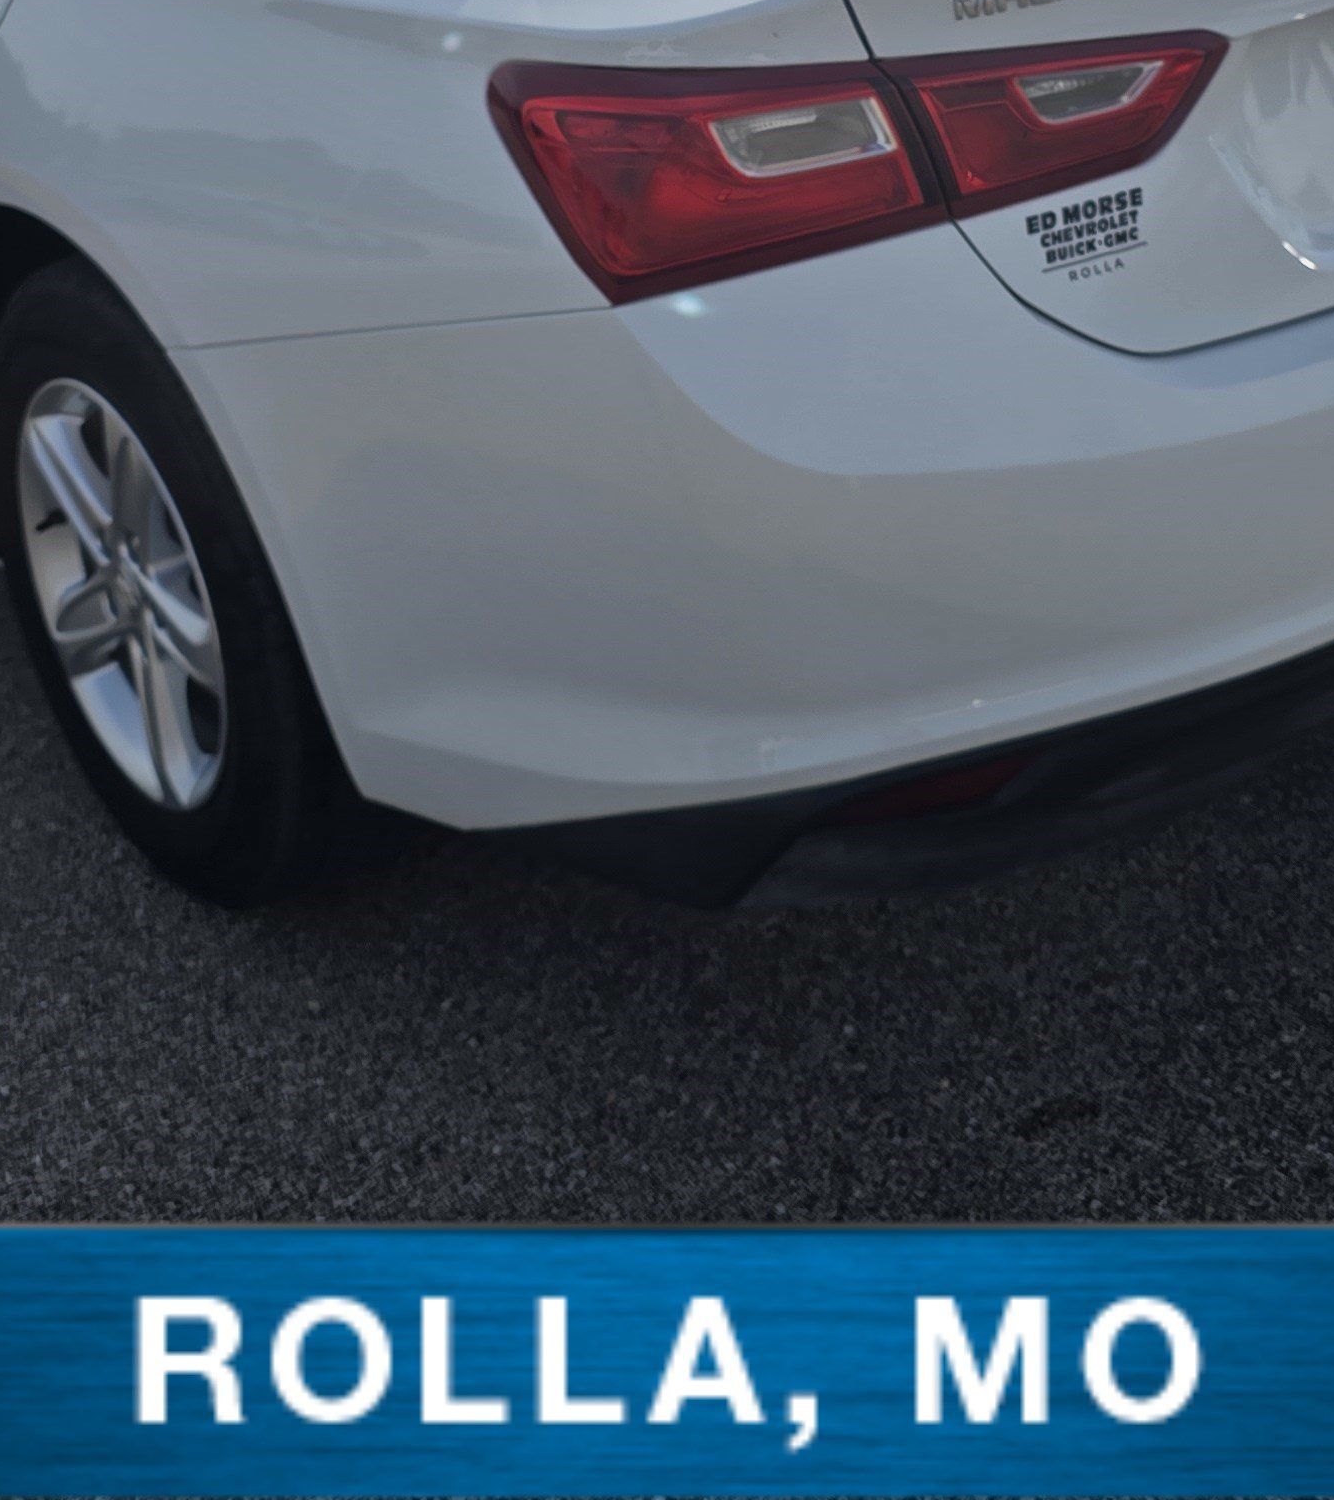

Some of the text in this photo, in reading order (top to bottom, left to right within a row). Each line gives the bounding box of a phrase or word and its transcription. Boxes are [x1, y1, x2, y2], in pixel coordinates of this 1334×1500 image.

[1025, 186, 1144, 236] ED MORSE
[1040, 209, 1139, 248] CHEVROLET
[1068, 257, 1125, 282] ROLLA
